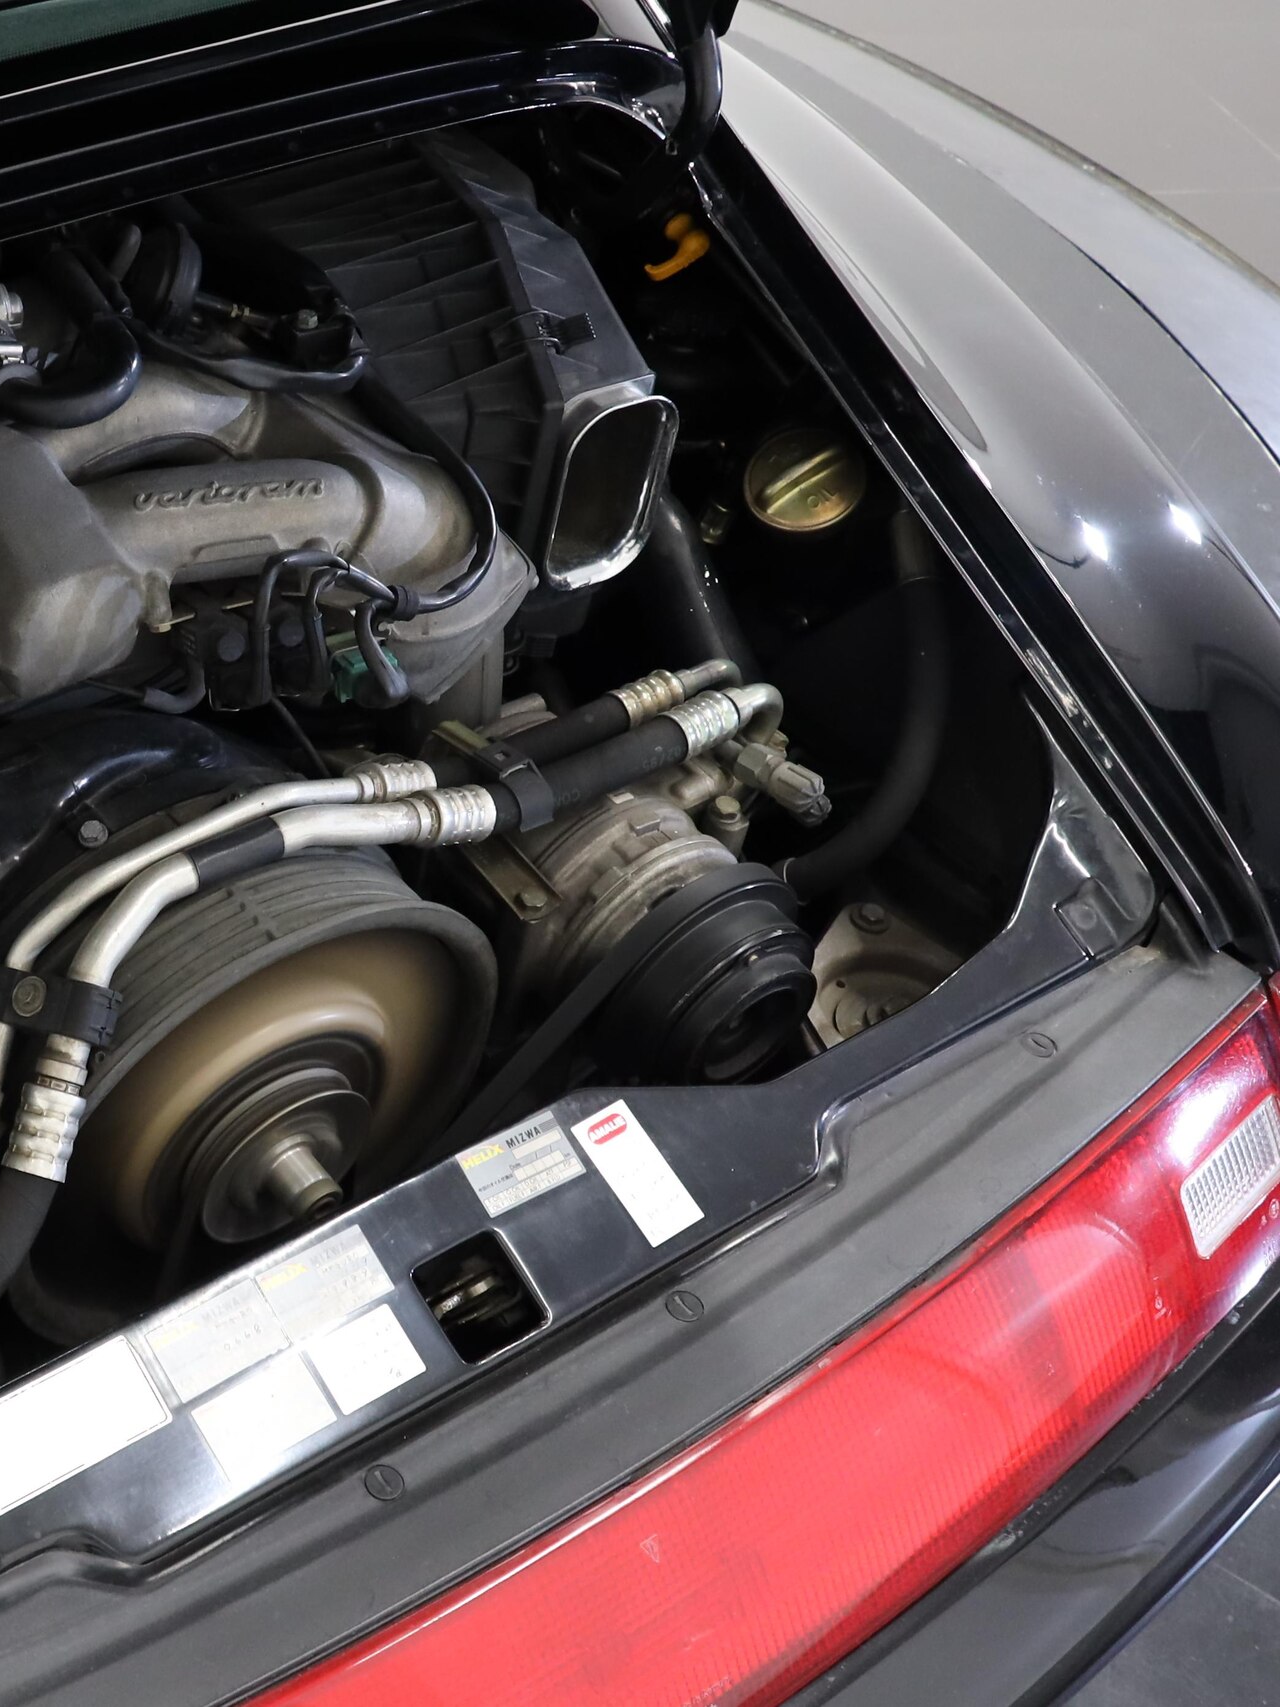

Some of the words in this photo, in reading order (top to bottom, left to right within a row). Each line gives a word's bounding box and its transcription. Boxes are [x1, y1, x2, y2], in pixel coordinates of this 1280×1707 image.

[807, 488, 839, 510] OIL
[588, 1115, 627, 1141] AMALIE
[461, 1143, 505, 1170] HELIX
[505, 1126, 541, 1149] MIZWA
